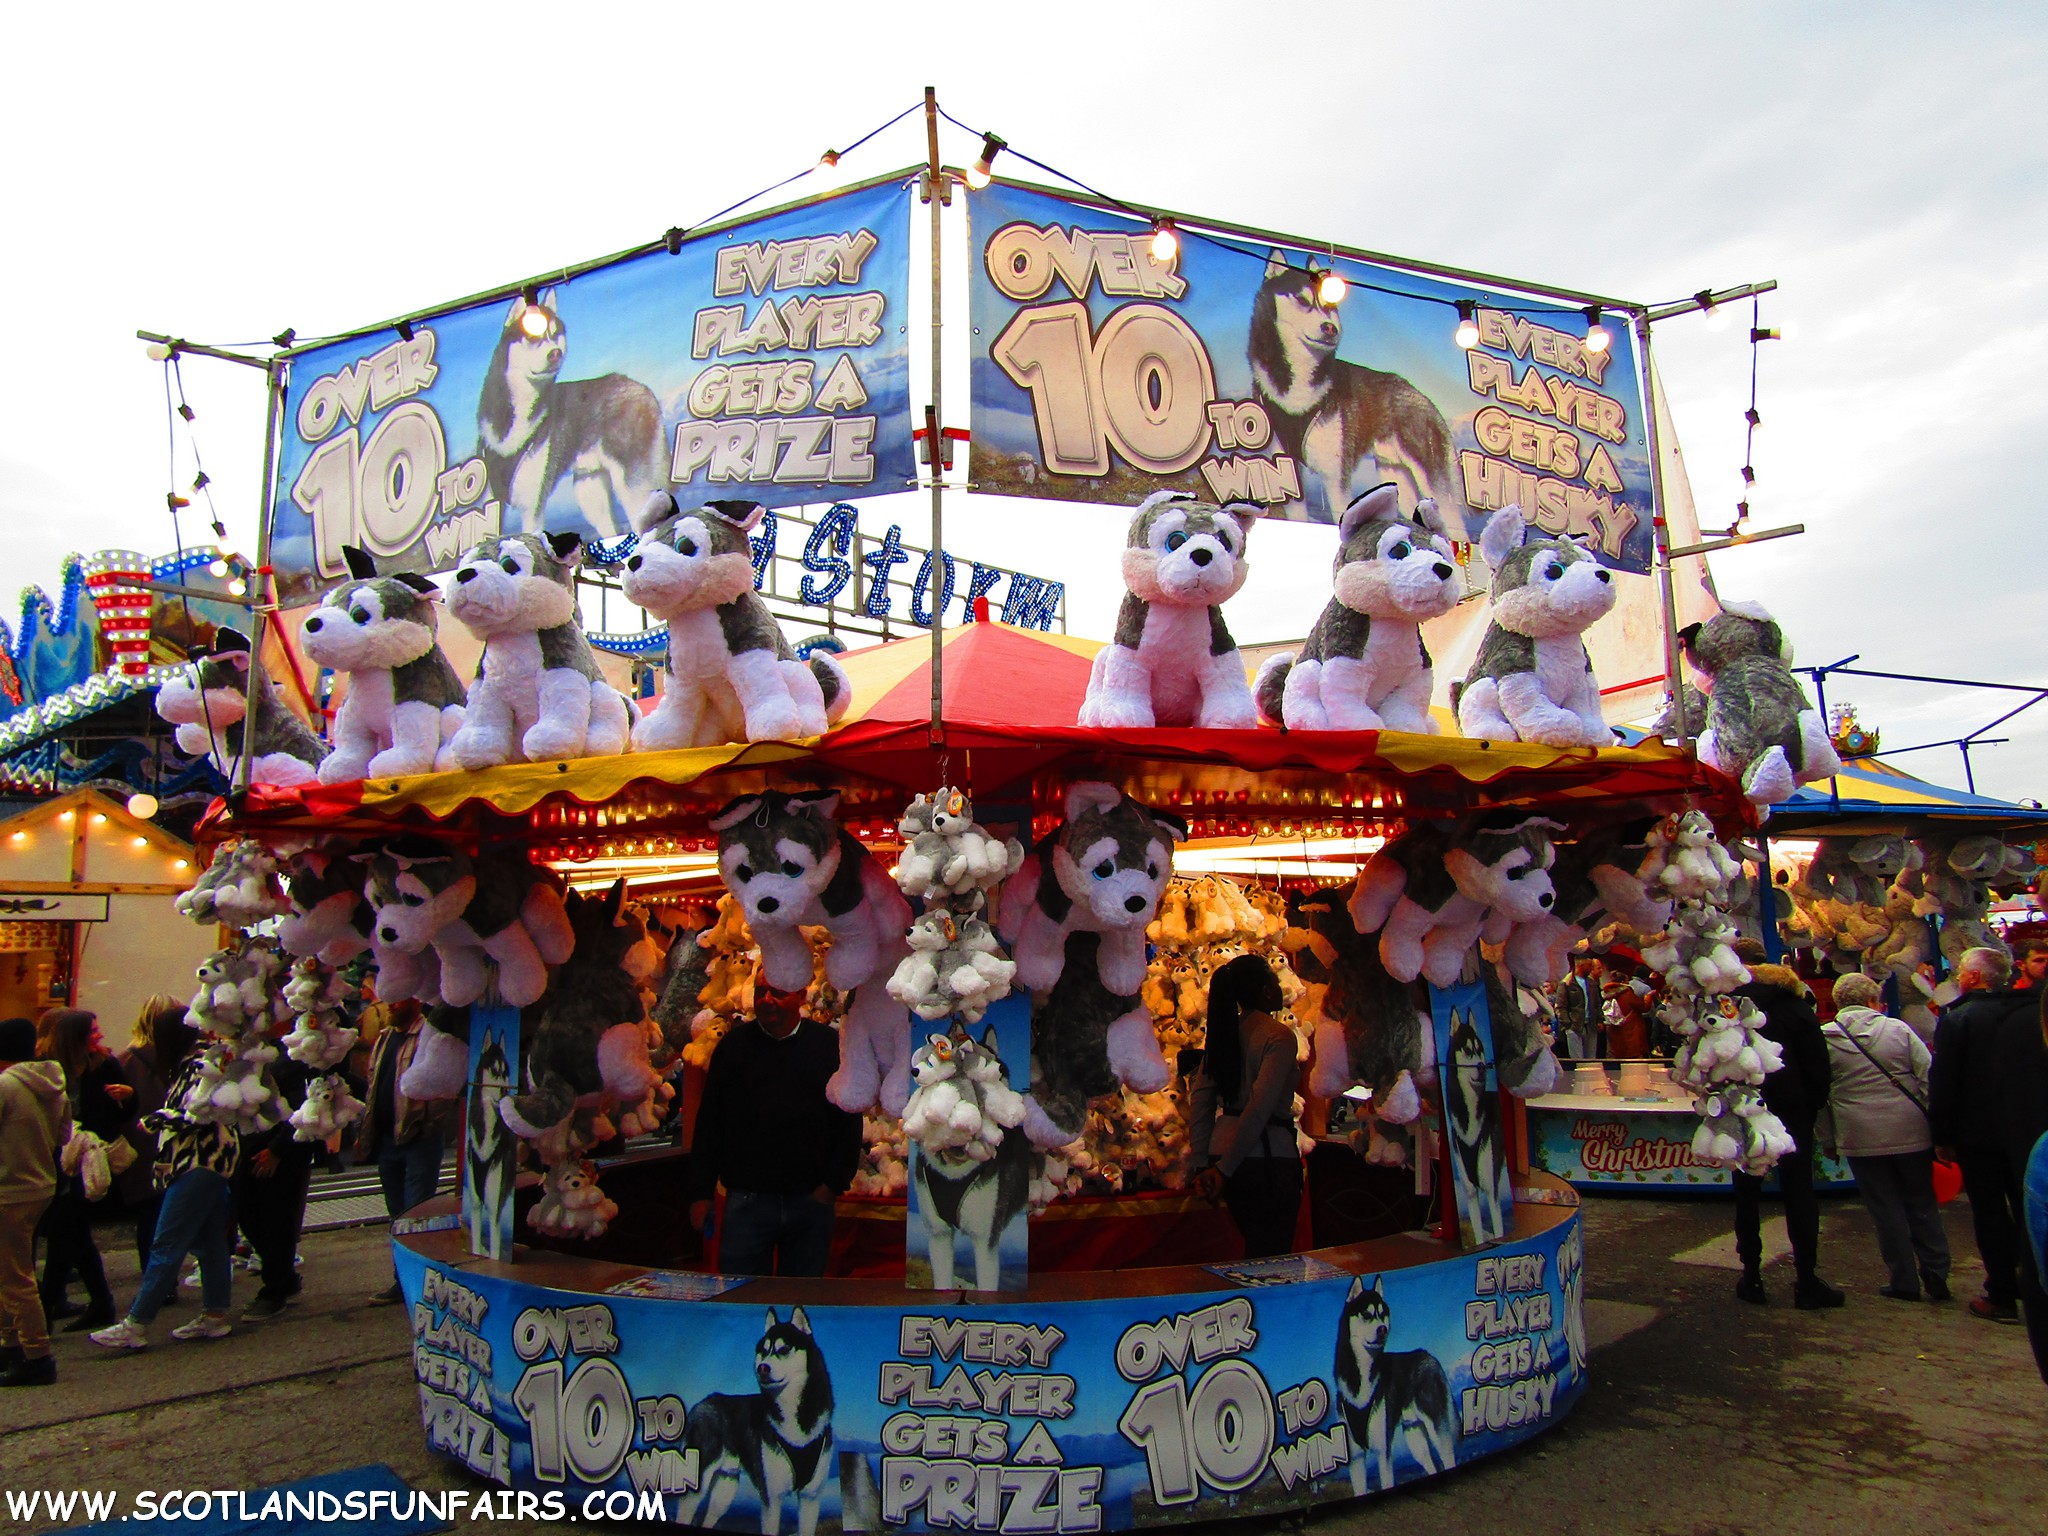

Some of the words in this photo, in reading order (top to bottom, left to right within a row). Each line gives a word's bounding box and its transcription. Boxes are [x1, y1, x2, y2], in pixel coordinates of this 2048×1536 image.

[714, 228, 878, 300] EVERY
[984, 219, 1190, 301] OVER
[691, 290, 888, 360] PLAYER
[1477, 307, 1611, 386] EVERY
[296, 326, 439, 442] OVER
[687, 360, 816, 418] GETS
[813, 354, 868, 412] A
[989, 299, 1217, 478] 10
[1466, 349, 1626, 444] PLAYER
[670, 413, 877, 485] PRIZE
[1206, 398, 1273, 452] TO
[1474, 405, 1581, 479] GETS
[1583, 442, 1625, 494] A
[293, 399, 445, 579] 10
[437, 457, 488, 514] TO
[1202, 453, 1304, 506] WIN
[1461, 449, 1640, 560] HUSKY
[424, 500, 500, 568] WIN
[1572, 1119, 1629, 1146] Merry
[1581, 1138, 1722, 1173] Christm
[422, 1266, 489, 1331] EVERY
[1475, 1253, 1546, 1296] EVERY
[414, 1302, 492, 1378] PLAYER
[512, 1303, 621, 1363] OVER
[900, 1315, 1066, 1368] EVERY
[1115, 1295, 1260, 1382] OVER
[1466, 1292, 1553, 1340] PLAYER
[416, 1346, 470, 1400] GETS
[470, 1374, 493, 1414] A
[879, 1361, 1076, 1419] PLAYER
[1471, 1337, 1532, 1384] GETS
[1533, 1333, 1552, 1372] A
[418, 1381, 511, 1487] PRIZE
[512, 1358, 635, 1484] 10
[637, 1396, 686, 1443] TO
[881, 1411, 1009, 1463] GETS
[1012, 1420, 1064, 1465] A
[1118, 1357, 1277, 1507] 10
[1277, 1377, 1331, 1435] TO
[1461, 1372, 1558, 1436] HUSKY
[625, 1446, 700, 1495] WIN
[1269, 1423, 1350, 1491] WIN
[881, 1455, 1104, 1535] PRIZE
